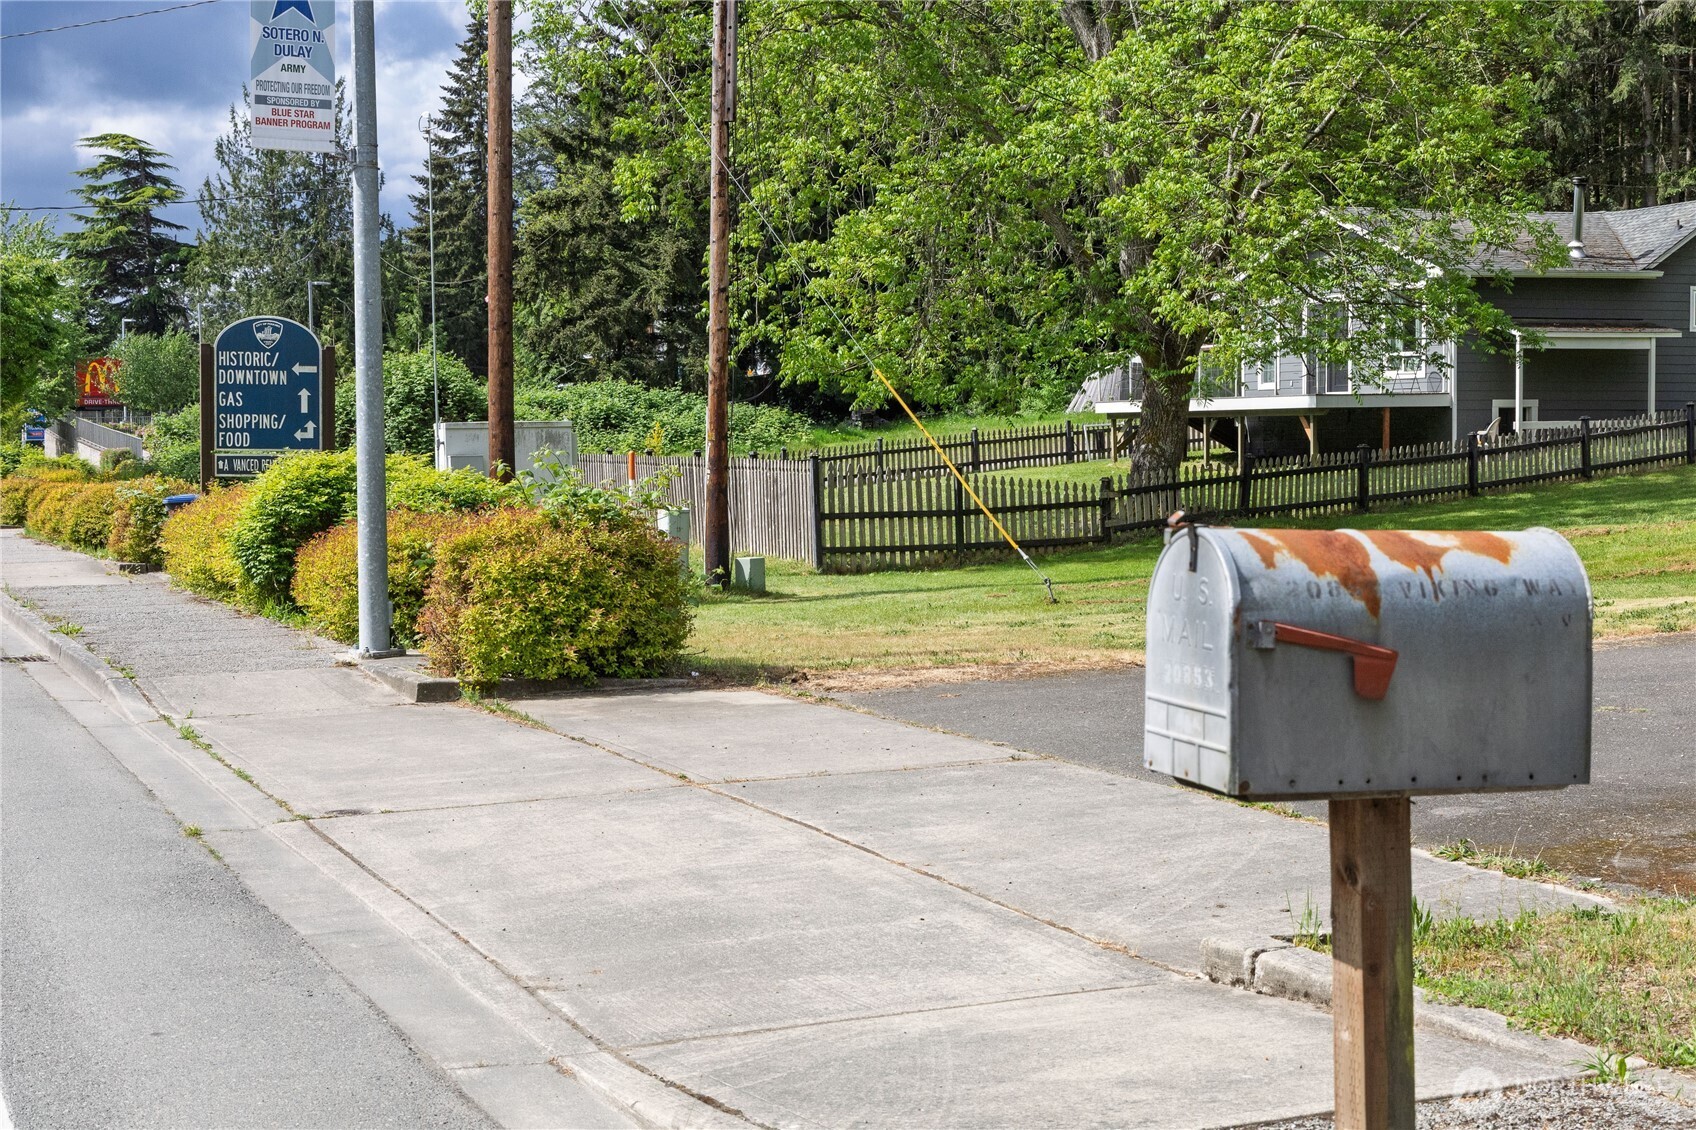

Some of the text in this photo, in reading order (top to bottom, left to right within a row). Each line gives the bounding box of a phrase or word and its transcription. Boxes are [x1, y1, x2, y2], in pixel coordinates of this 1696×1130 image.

[262, 26, 325, 43] SOTERO N.
[274, 43, 313, 58] DULAY
[280, 63, 306, 74] ARMY
[255, 80, 331, 97] PROTECTING OUR FREEDOM
[266, 96, 309, 107] SPONSORED
[271, 107, 315, 119] BLUE STAR
[255, 117, 331, 130] BANNER PROGRAM
[218, 351, 280, 367] HISTORIC/
[218, 369, 287, 385] DOWNTOWN
[218, 391, 243, 407] GAS
[218, 413, 286, 429] SHOPPING/
[218, 432, 250, 447] FOOD
[1199, 576, 1214, 606] S.
[1161, 614, 1214, 652] MAIL
